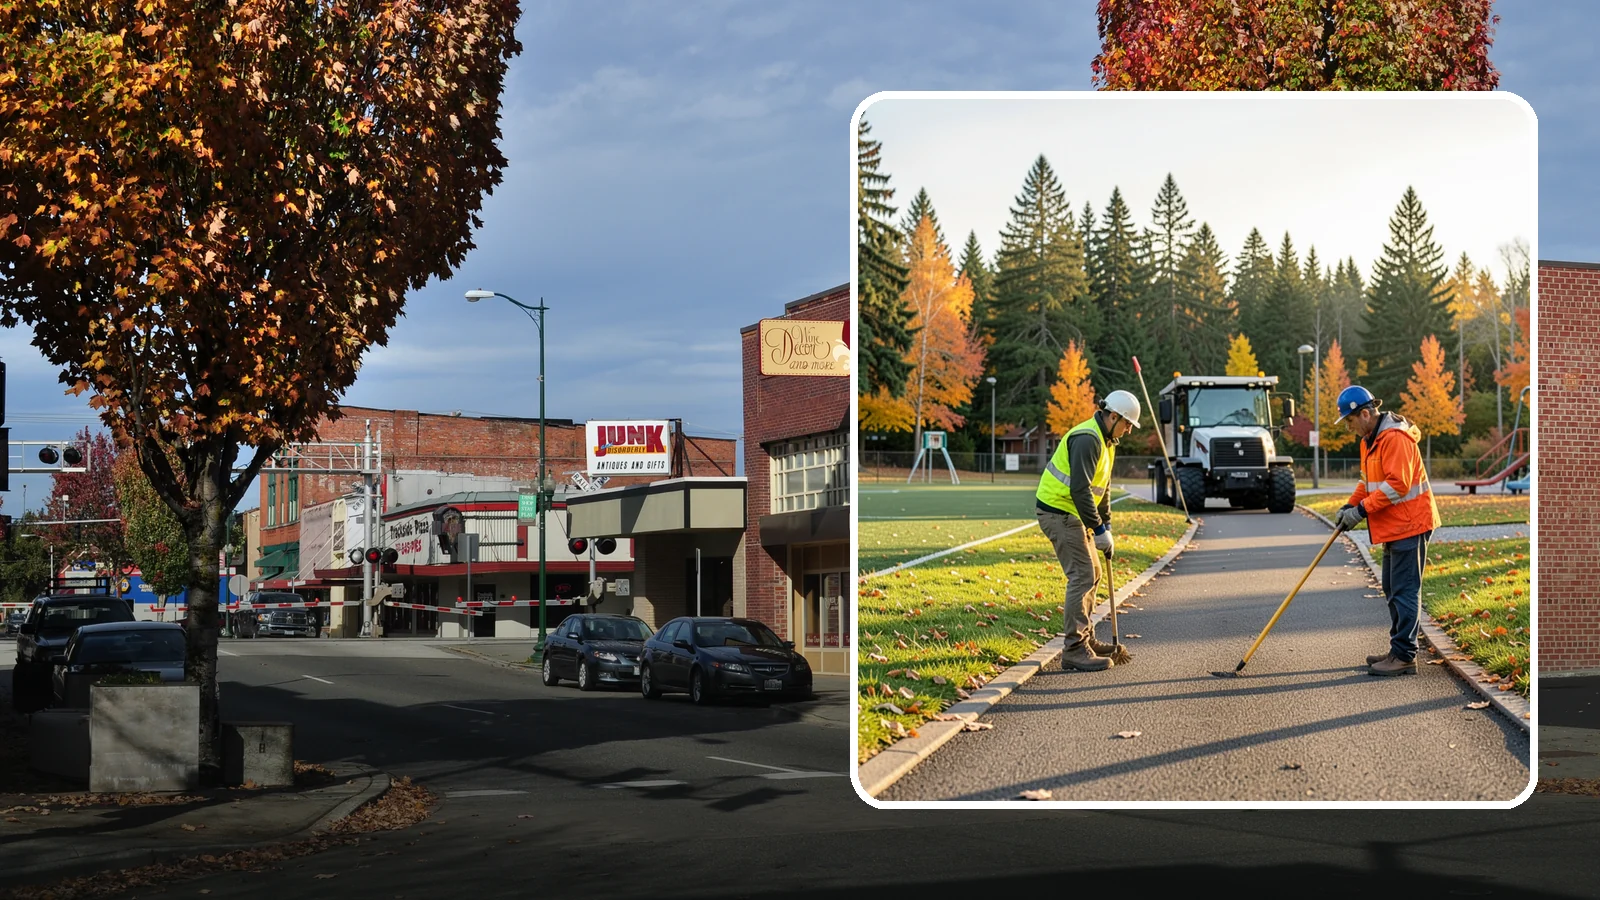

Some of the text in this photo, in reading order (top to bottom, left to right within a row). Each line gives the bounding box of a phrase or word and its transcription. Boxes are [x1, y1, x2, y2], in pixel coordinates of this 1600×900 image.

[595, 425, 665, 457] JUNK
[607, 446, 646, 454] DISORDERLY
[596, 460, 665, 470] ANTIQUES AND GIFTS
[573, 473, 589, 491] RAIL
[590, 475, 608, 491] SING
[390, 519, 429, 540] Trackside Pizza
